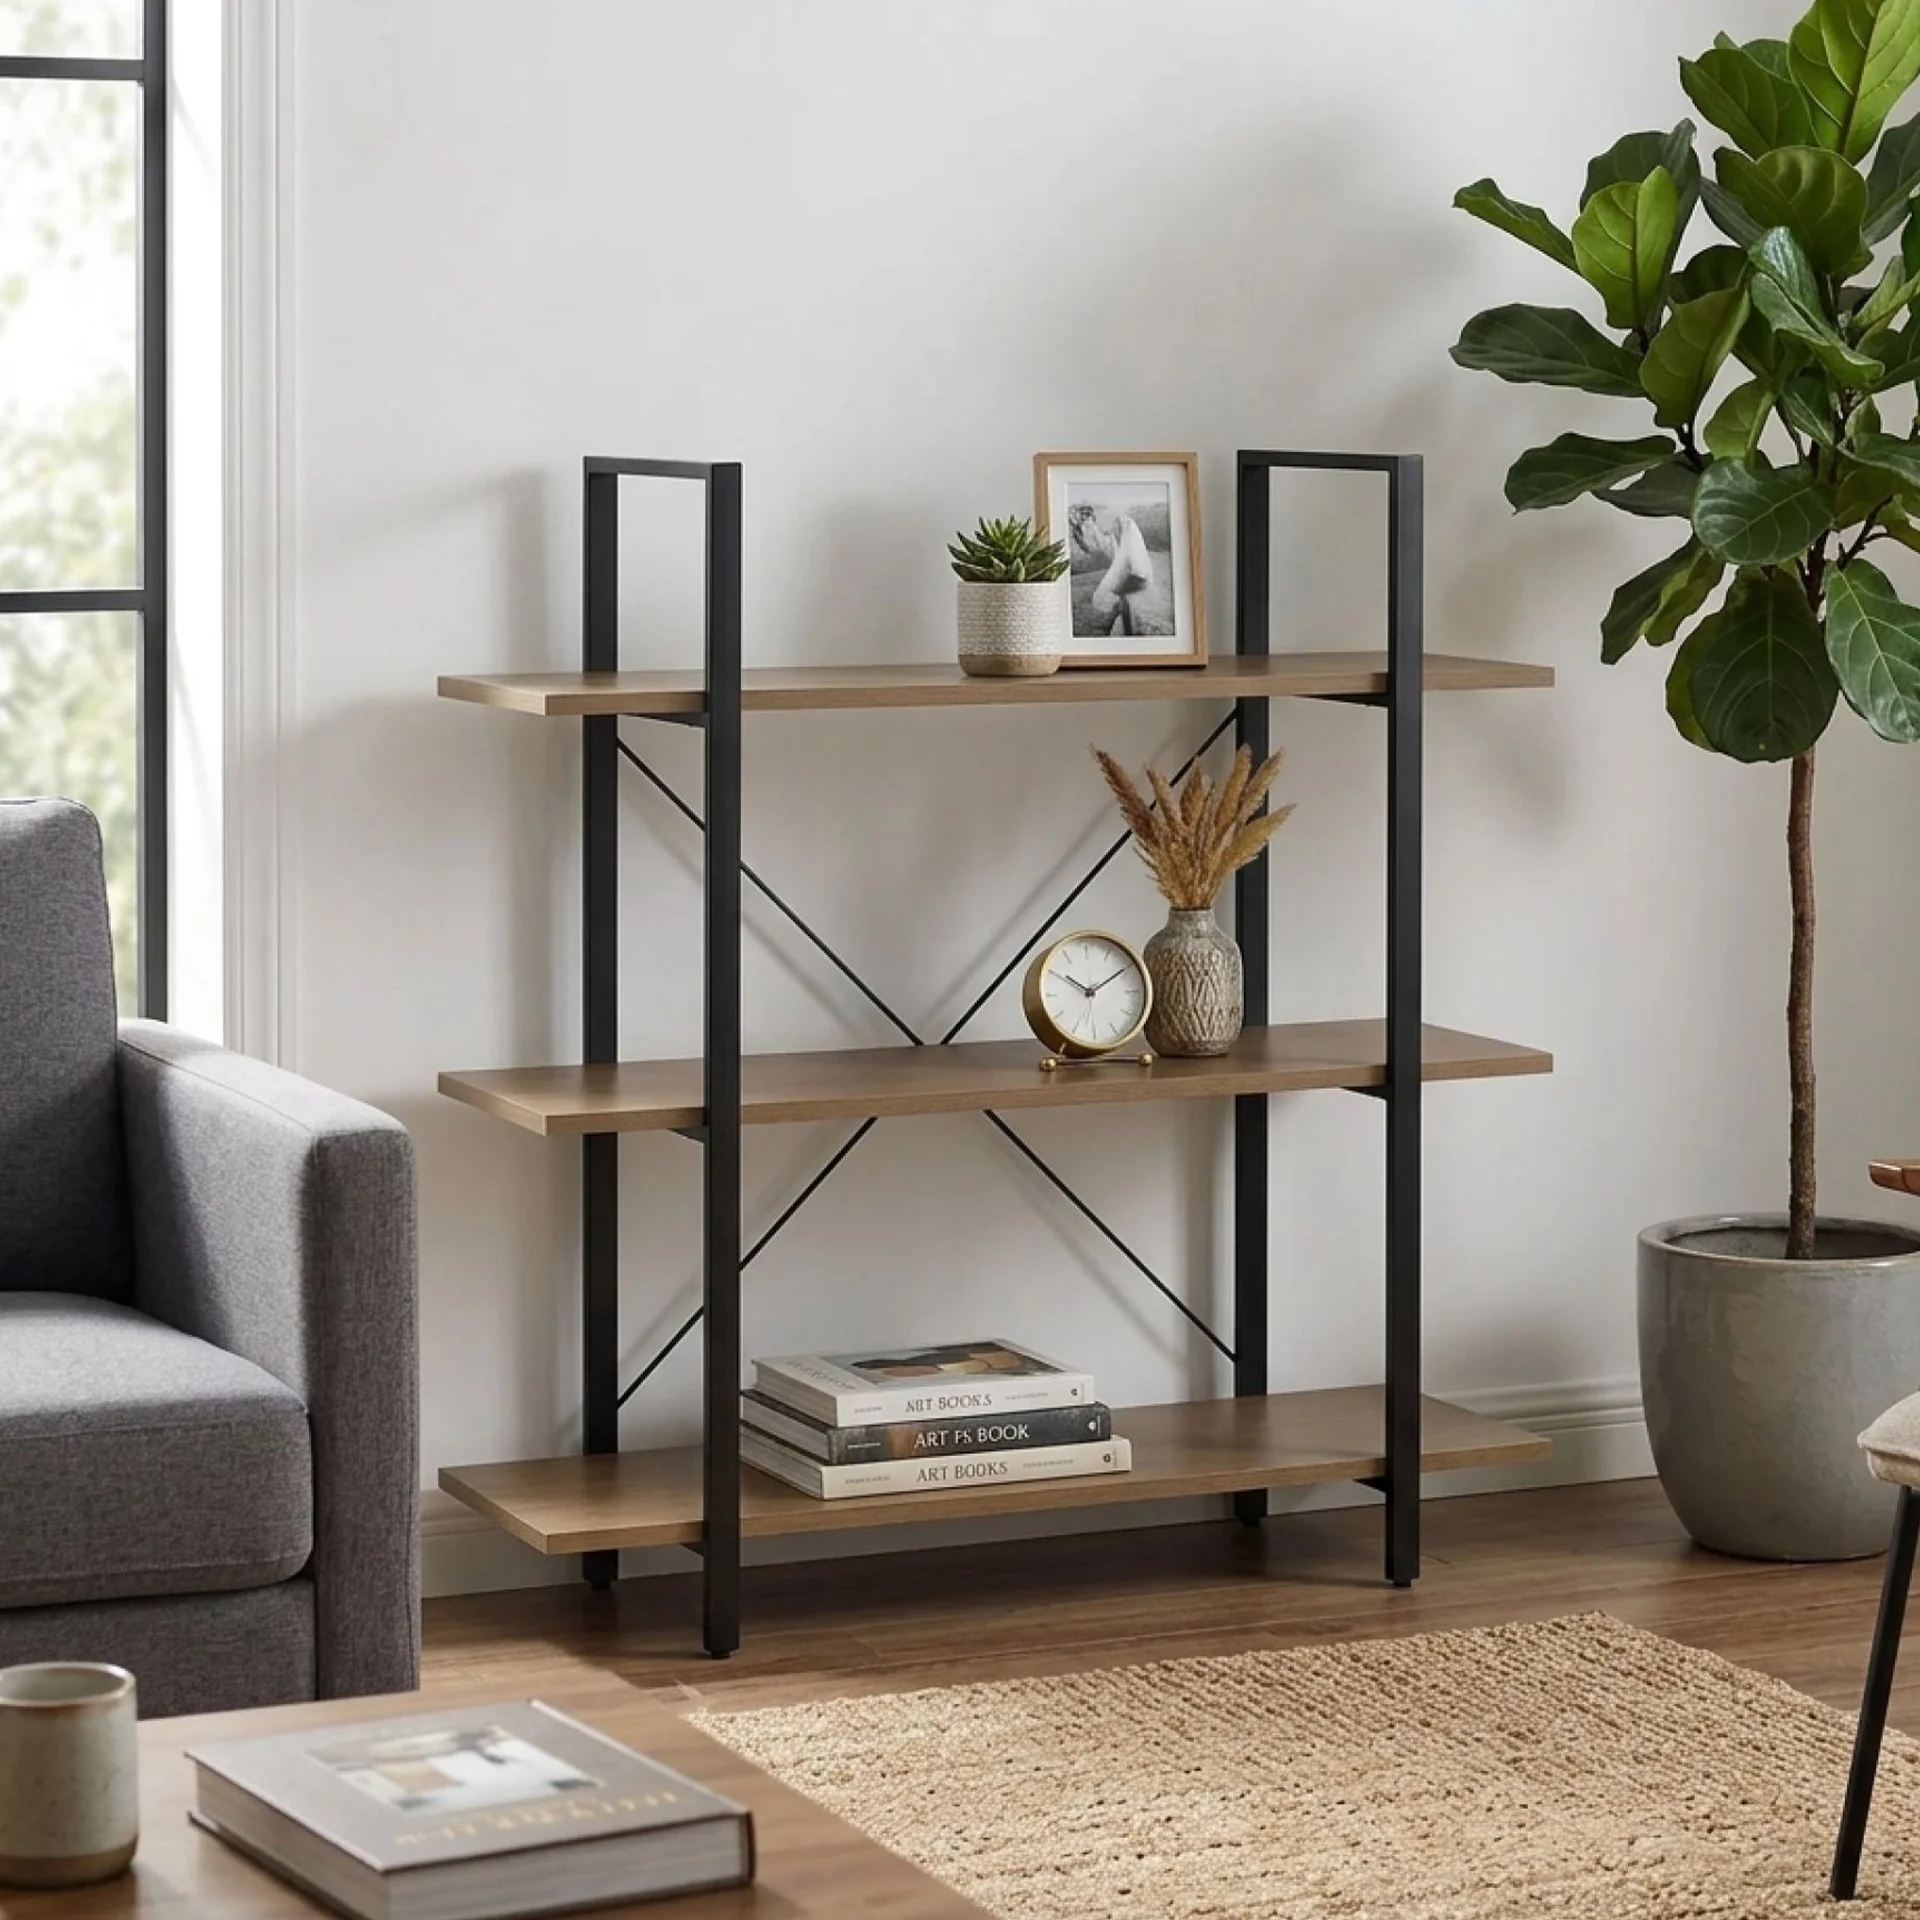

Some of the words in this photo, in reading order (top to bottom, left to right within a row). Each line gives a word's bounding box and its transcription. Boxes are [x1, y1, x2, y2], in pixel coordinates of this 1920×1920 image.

[914, 1430, 949, 1449] ART
[977, 1424, 1029, 1442] BOOK
[917, 1466, 948, 1482] ART
[955, 1461, 1008, 1479] BOOKS
